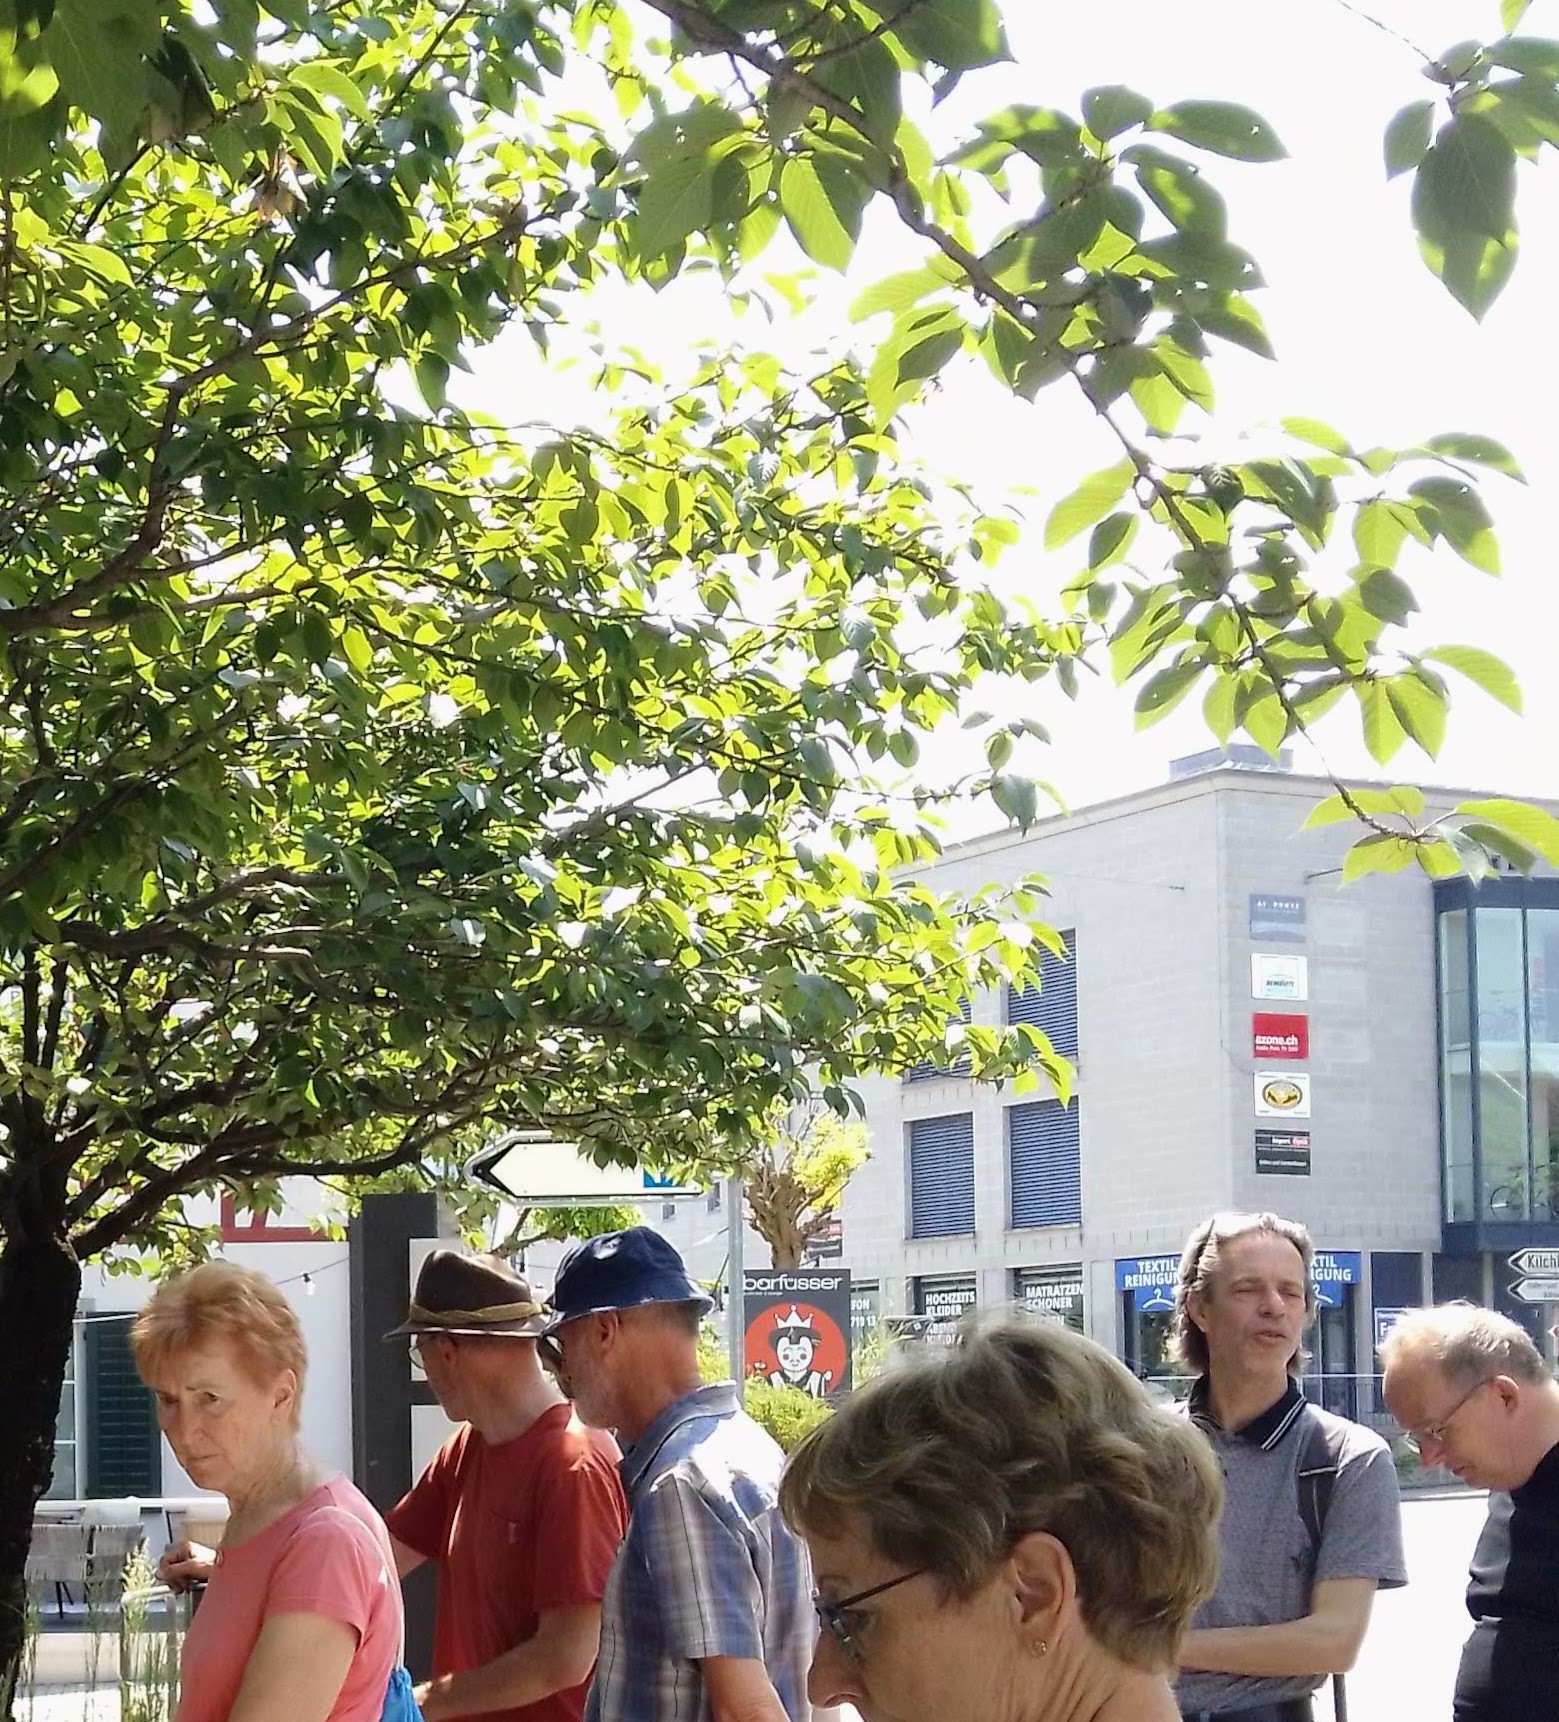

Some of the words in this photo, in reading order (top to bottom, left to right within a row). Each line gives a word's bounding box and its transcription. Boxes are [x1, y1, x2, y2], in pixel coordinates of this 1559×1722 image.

[1137, 1258, 1177, 1274] TEXTIL
[1527, 1254, 1559, 1268] Kilch
[1025, 1283, 1084, 1298] MATRATZEN
[925, 1291, 976, 1305] HOCHZEITS
